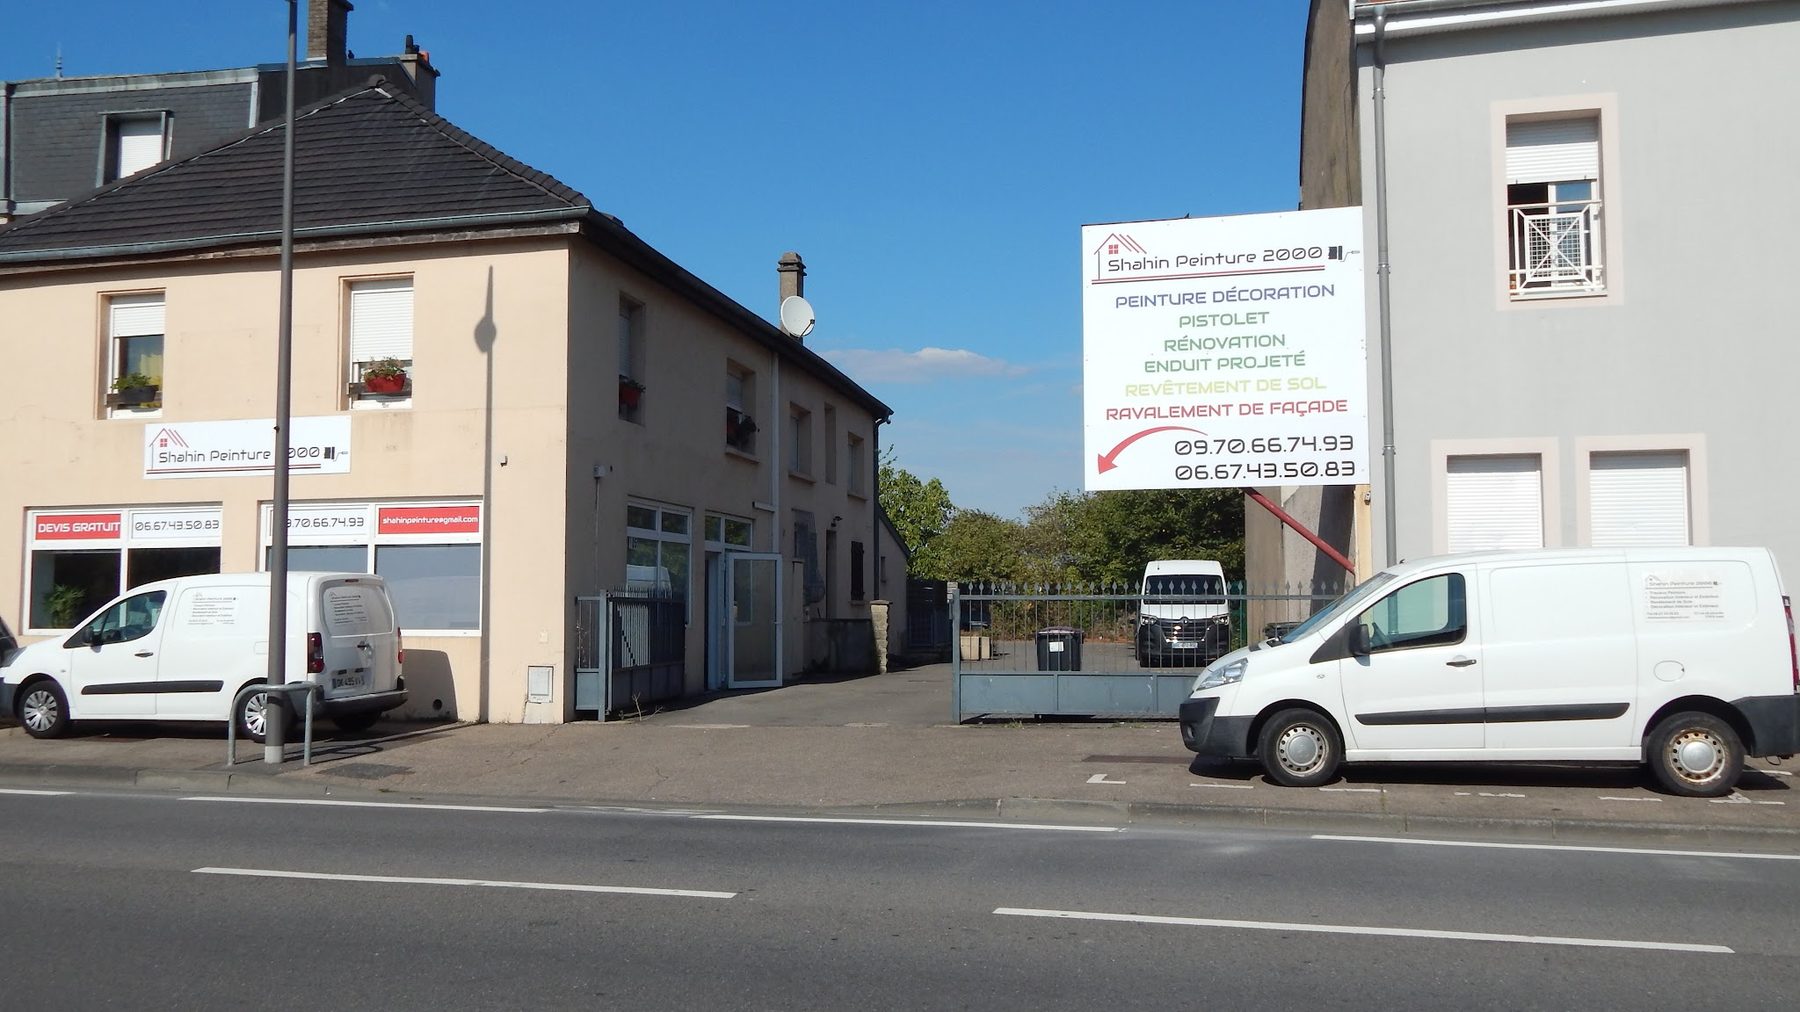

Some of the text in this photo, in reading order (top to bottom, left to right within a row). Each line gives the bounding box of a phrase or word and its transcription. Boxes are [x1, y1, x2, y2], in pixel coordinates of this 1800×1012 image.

[1108, 246, 1323, 272] Shahin Peinture 2000
[1115, 284, 1335, 309] PEINTURE DÉCORATION
[1179, 311, 1270, 328] PISTOLET
[1164, 334, 1286, 353] RÉNOVATION
[1144, 350, 1306, 373] ENDUIT PROJETÉ
[1125, 377, 1327, 397] REVÊTEMENT DE SOL
[1106, 400, 1348, 421] RAVALEMENT DE FAÇADE
[1174, 435, 1354, 455] 09.70.66.74.93
[159, 450, 205, 464] Shahin
[209, 449, 271, 462] Peinture
[1175, 461, 1355, 481] 06.67.43.50.83
[38, 521, 121, 533] DEVIS GRATUIT
[135, 519, 219, 531] 06.67.43.50.83
[287, 517, 365, 528] 9.70.66.74.93
